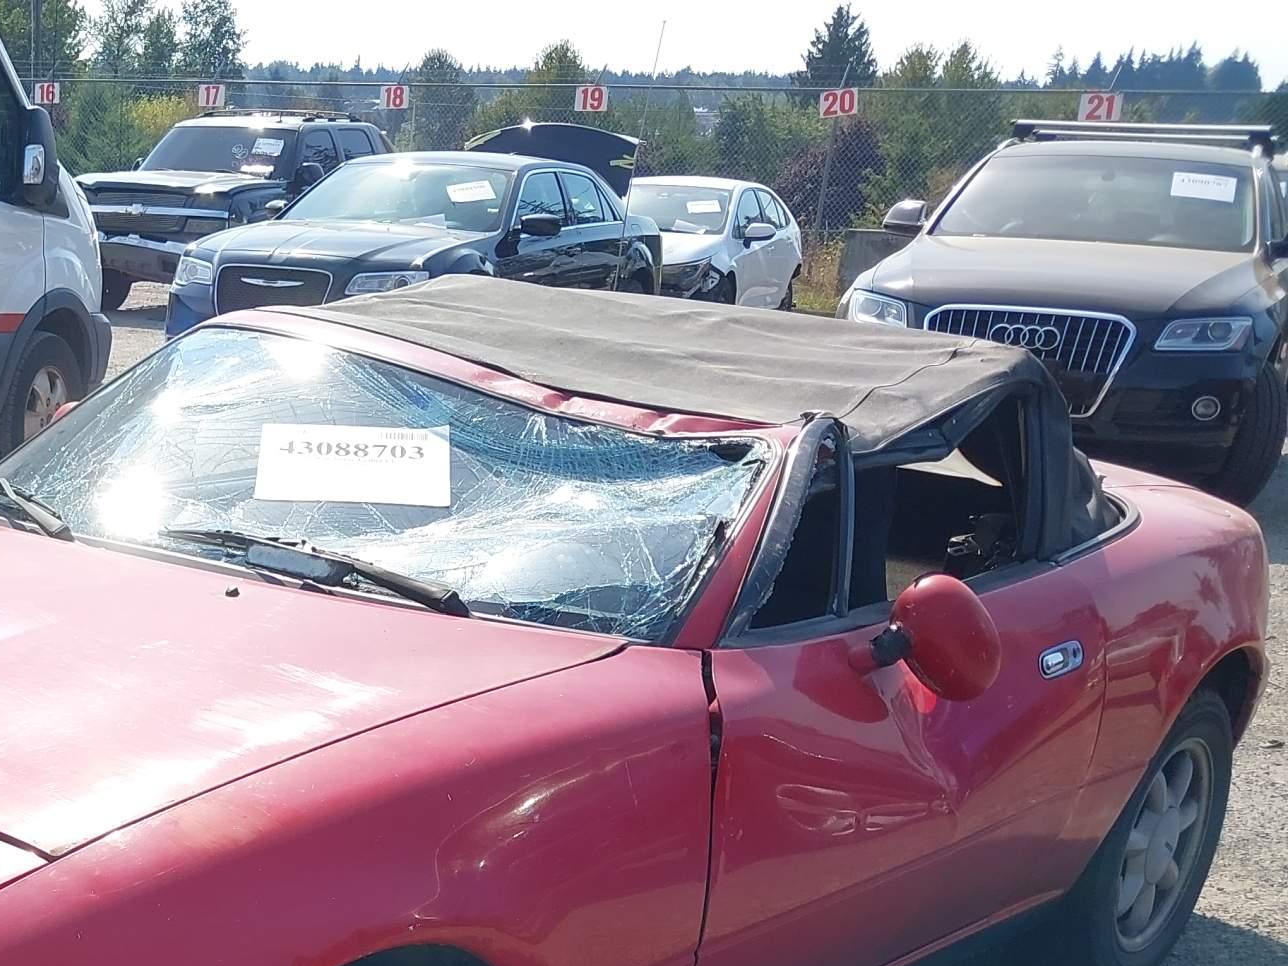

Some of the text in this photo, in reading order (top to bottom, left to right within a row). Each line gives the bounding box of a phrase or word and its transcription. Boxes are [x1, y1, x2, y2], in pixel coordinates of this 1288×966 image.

[39, 84, 56, 103] 16
[204, 85, 221, 105] 17
[385, 87, 404, 108] 18
[581, 87, 604, 110] 19
[822, 90, 855, 116] 20
[1085, 94, 1116, 121] 21
[279, 440, 425, 460] 43088703
